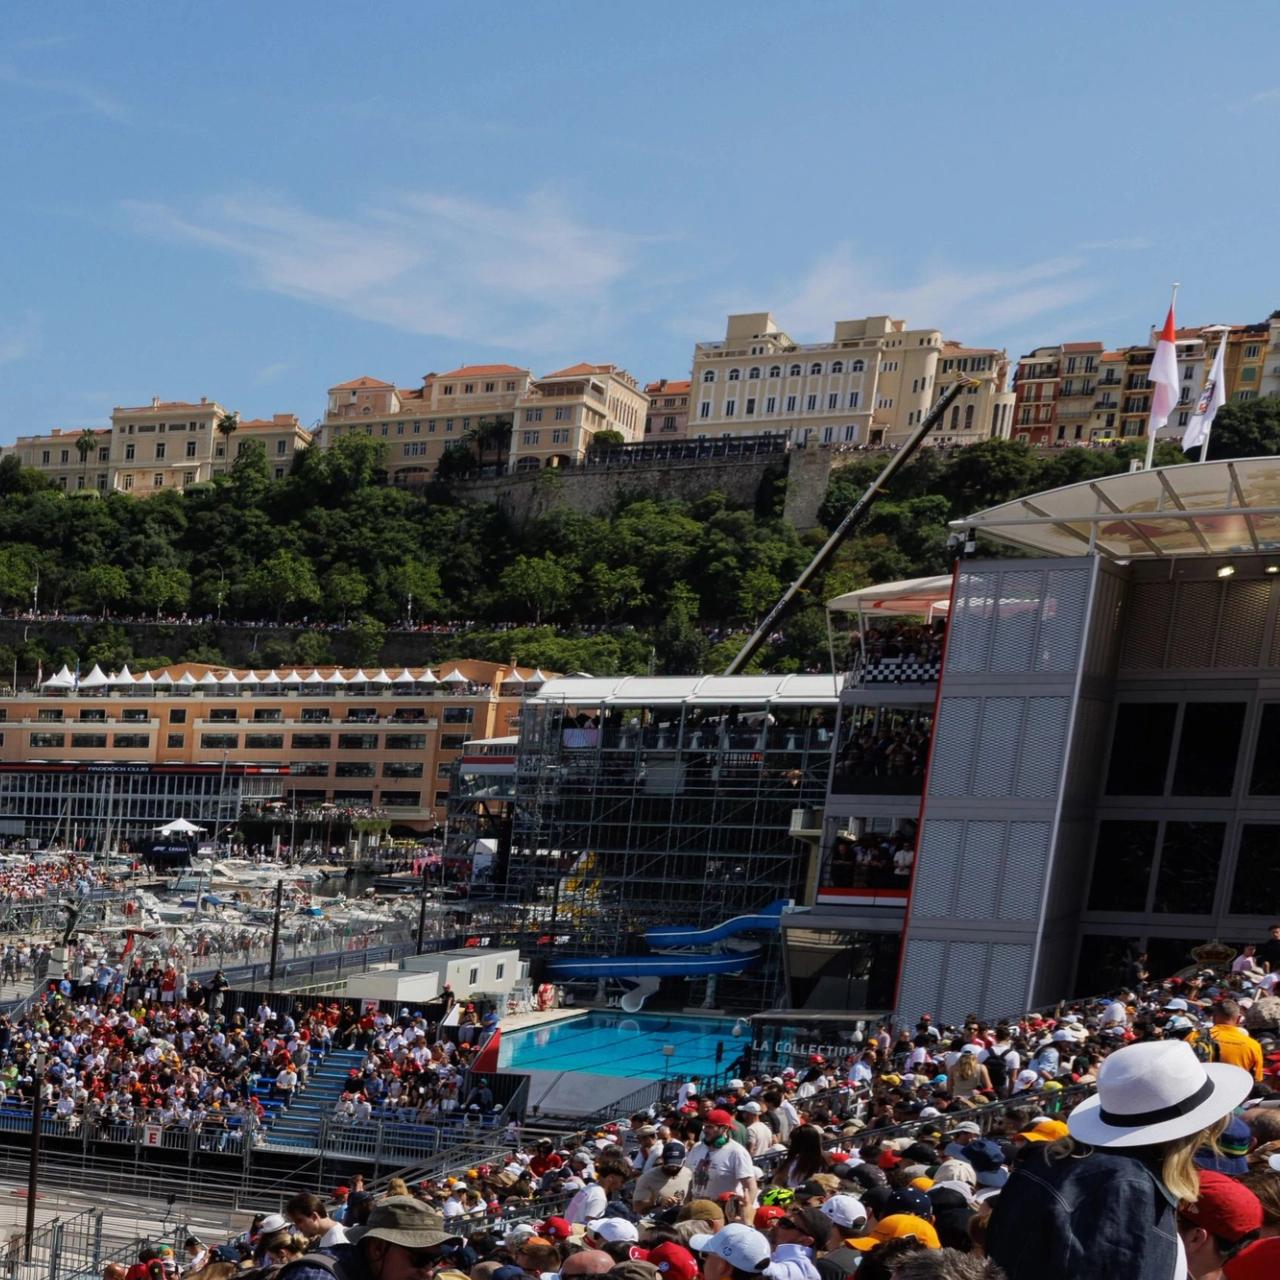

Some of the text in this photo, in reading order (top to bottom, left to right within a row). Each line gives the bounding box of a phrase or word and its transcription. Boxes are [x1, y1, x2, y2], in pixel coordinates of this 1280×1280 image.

[752, 1040, 858, 1058] LA COLLECTION
[149, 1132, 158, 1145] E
